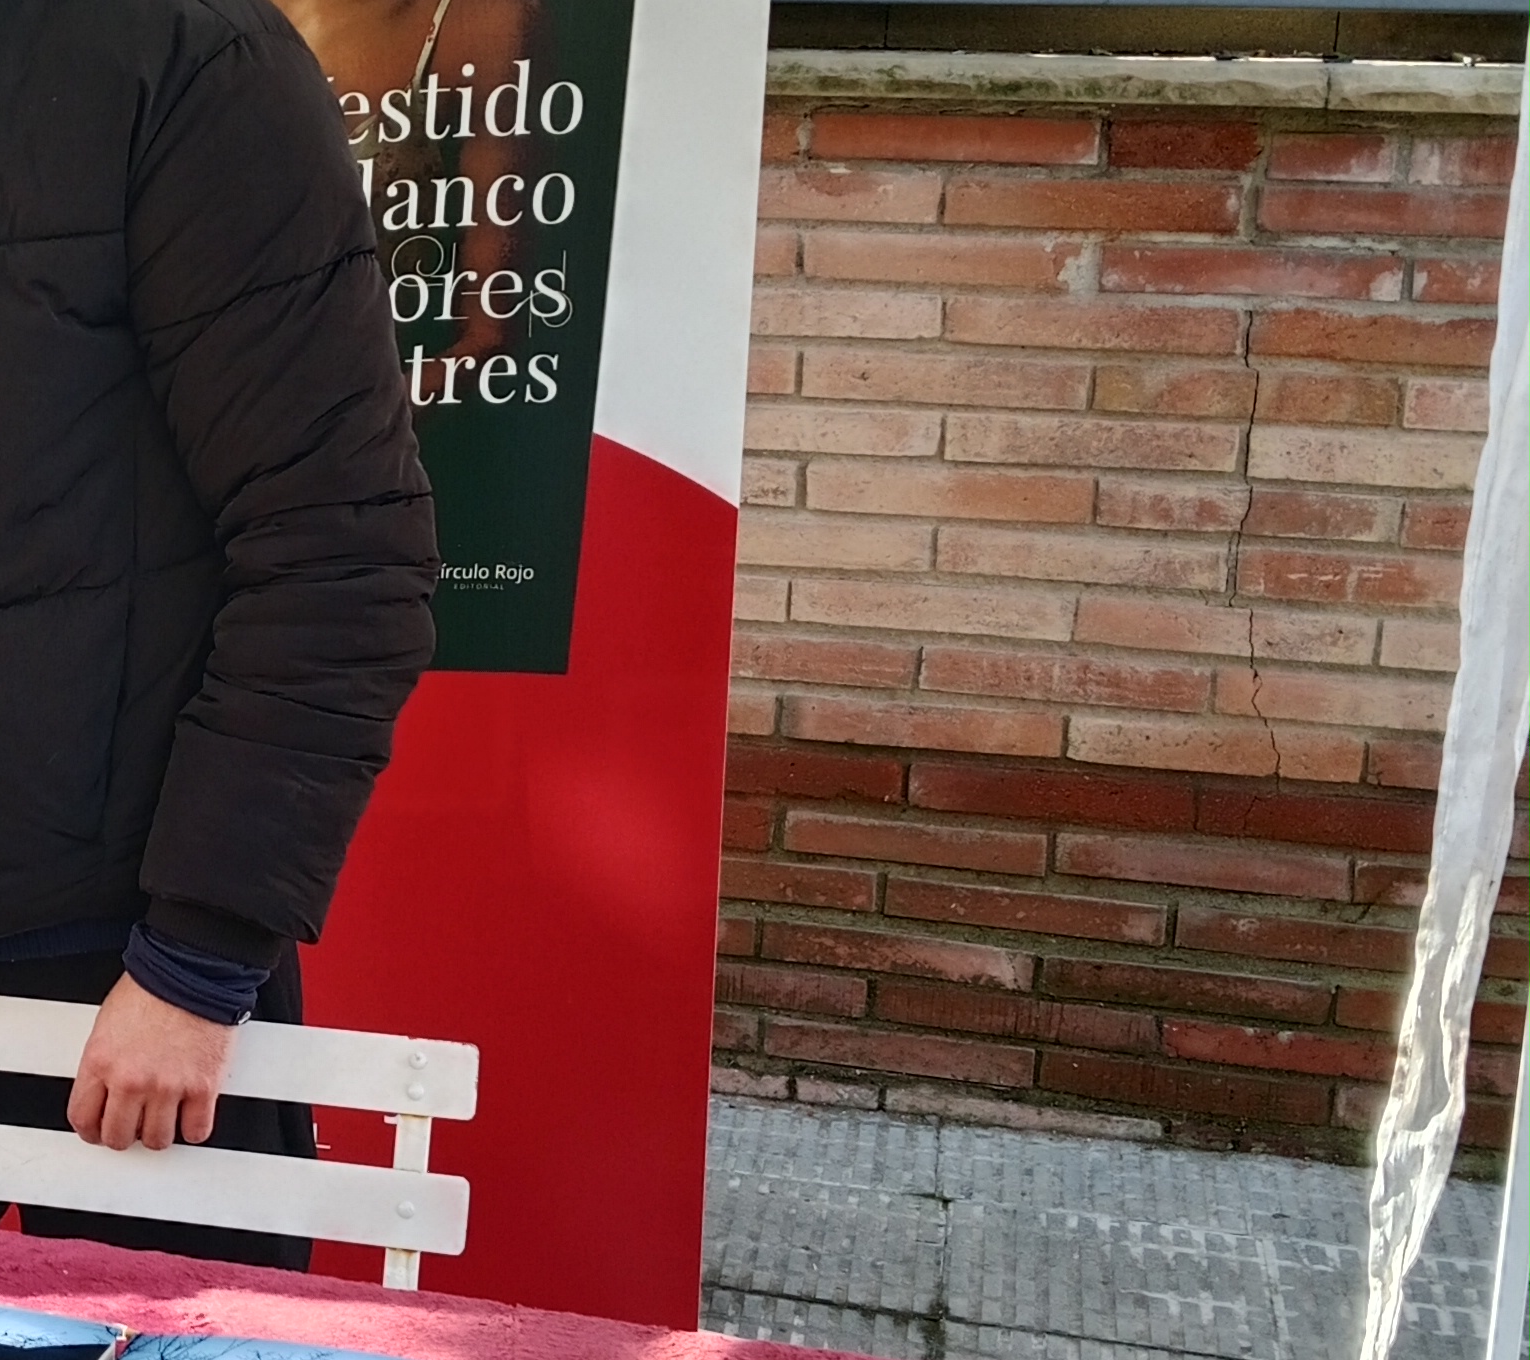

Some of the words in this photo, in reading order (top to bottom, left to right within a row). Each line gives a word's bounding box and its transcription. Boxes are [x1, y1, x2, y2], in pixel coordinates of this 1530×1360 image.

[327, 58, 585, 146] estido
[357, 158, 576, 232] lanco
[389, 236, 573, 338] ores
[405, 344, 560, 406] tres
[436, 562, 490, 580] írculo
[495, 563, 535, 585] Rojo
